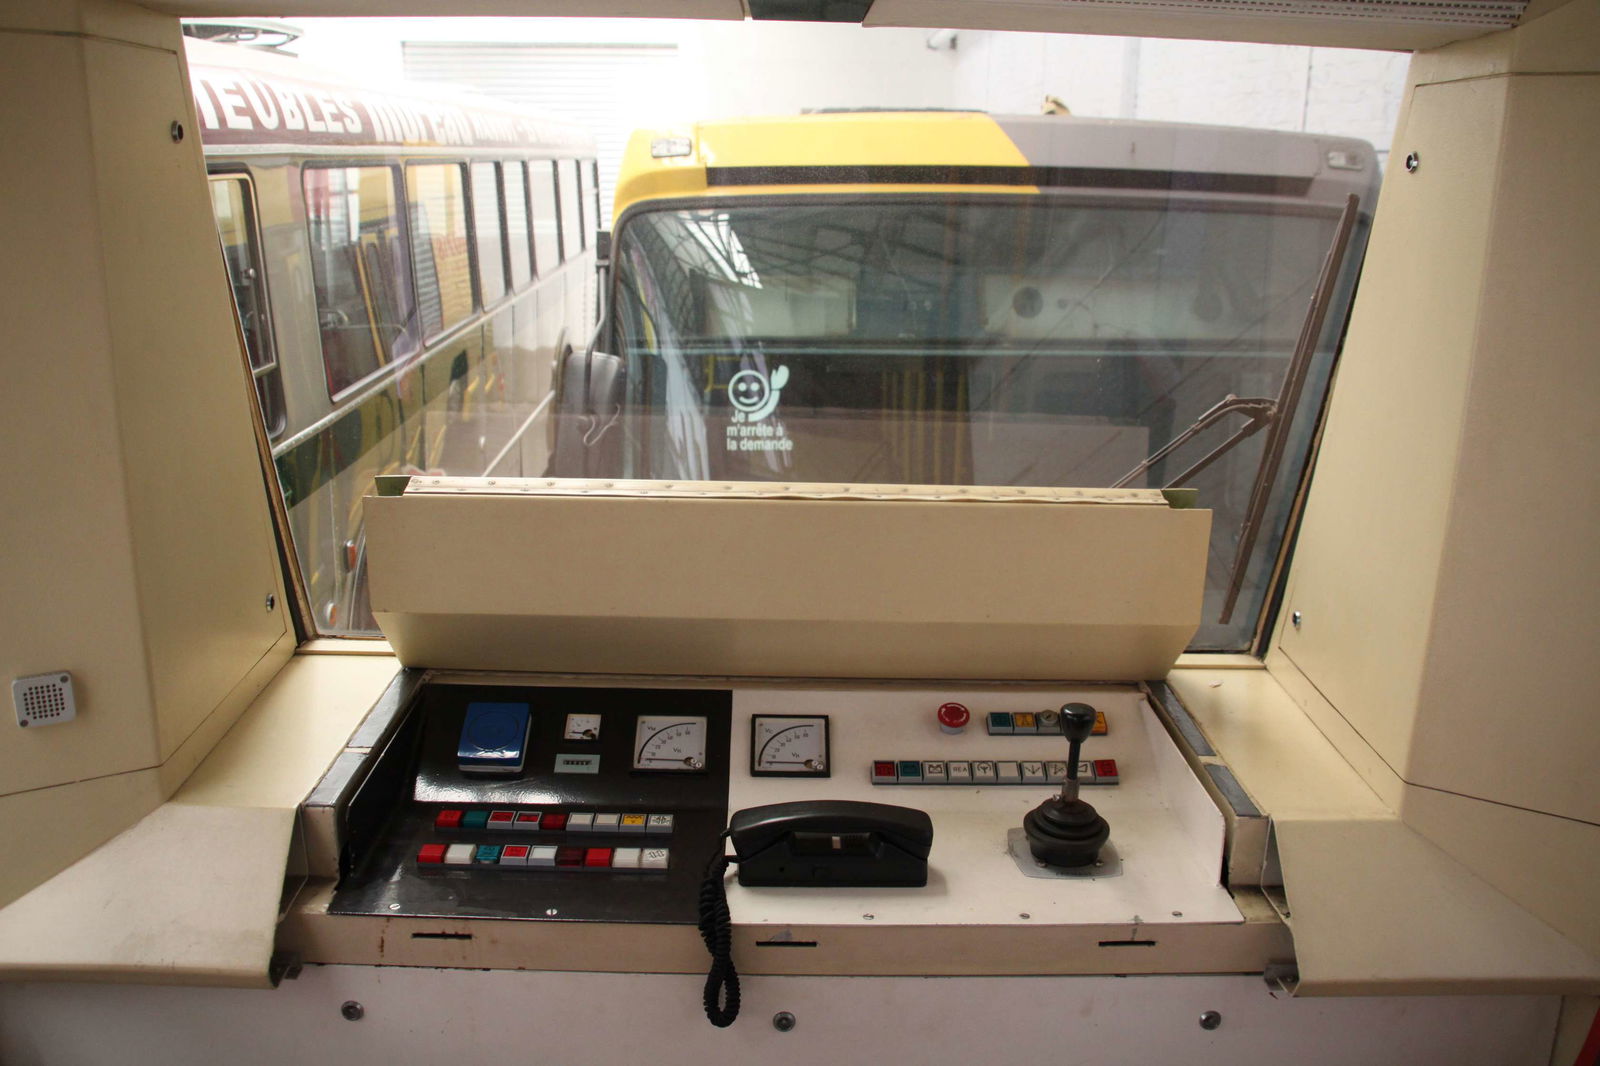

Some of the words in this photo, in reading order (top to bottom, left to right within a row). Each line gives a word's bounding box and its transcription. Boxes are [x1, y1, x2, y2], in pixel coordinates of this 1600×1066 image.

[731, 410, 746, 423] Je
[726, 437, 738, 451] la
[739, 437, 793, 451] demande
